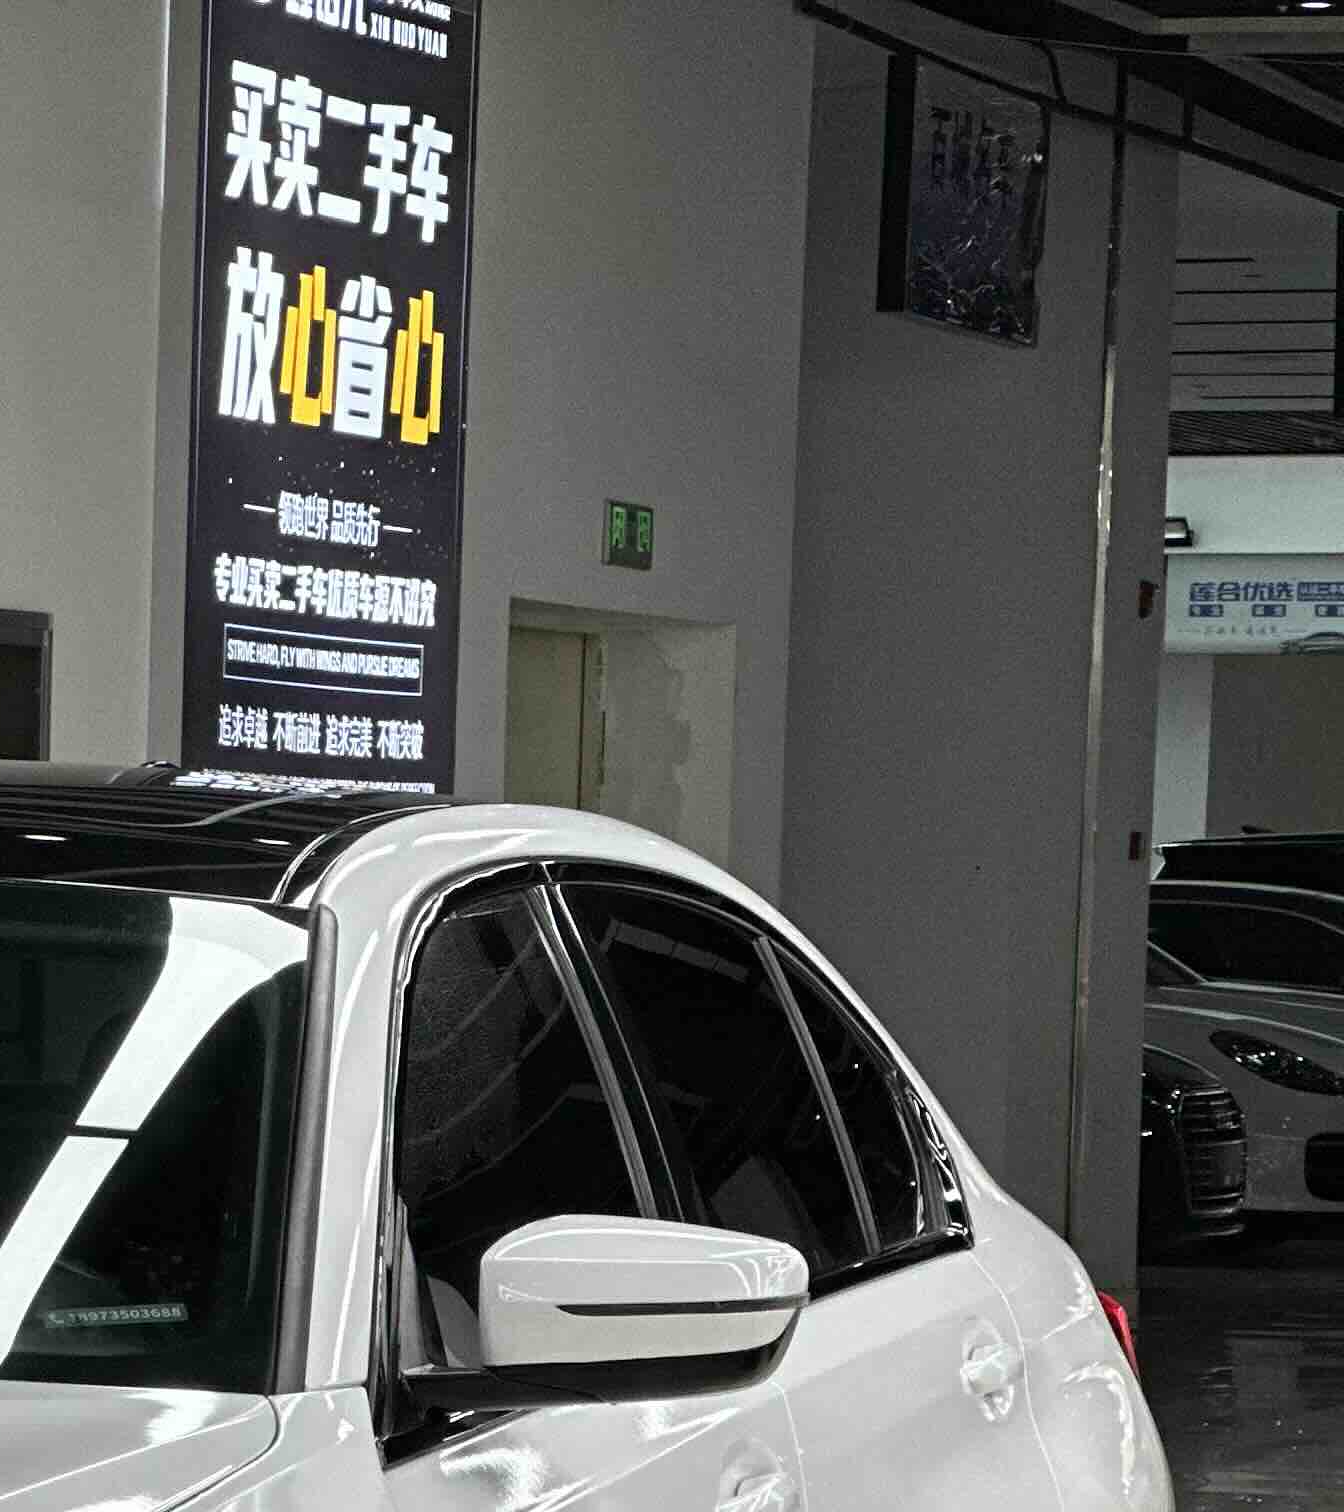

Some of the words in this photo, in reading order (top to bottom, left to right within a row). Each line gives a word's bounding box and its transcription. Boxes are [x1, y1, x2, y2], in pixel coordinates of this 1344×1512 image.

[224, 59, 454, 243] 买卖二手车
[218, 246, 445, 445] 放心省心
[330, 499, 381, 547] 品质先行
[227, 638, 256, 663] STRIVE
[281, 645, 296, 667] FLY
[341, 652, 358, 674] AND
[358, 653, 387, 677] PURSUE
[218, 703, 269, 749] 追求卓越
[273, 711, 321, 754] 不断前进
[325, 714, 374, 758] 追求完美
[377, 719, 425, 760] 不断突破
